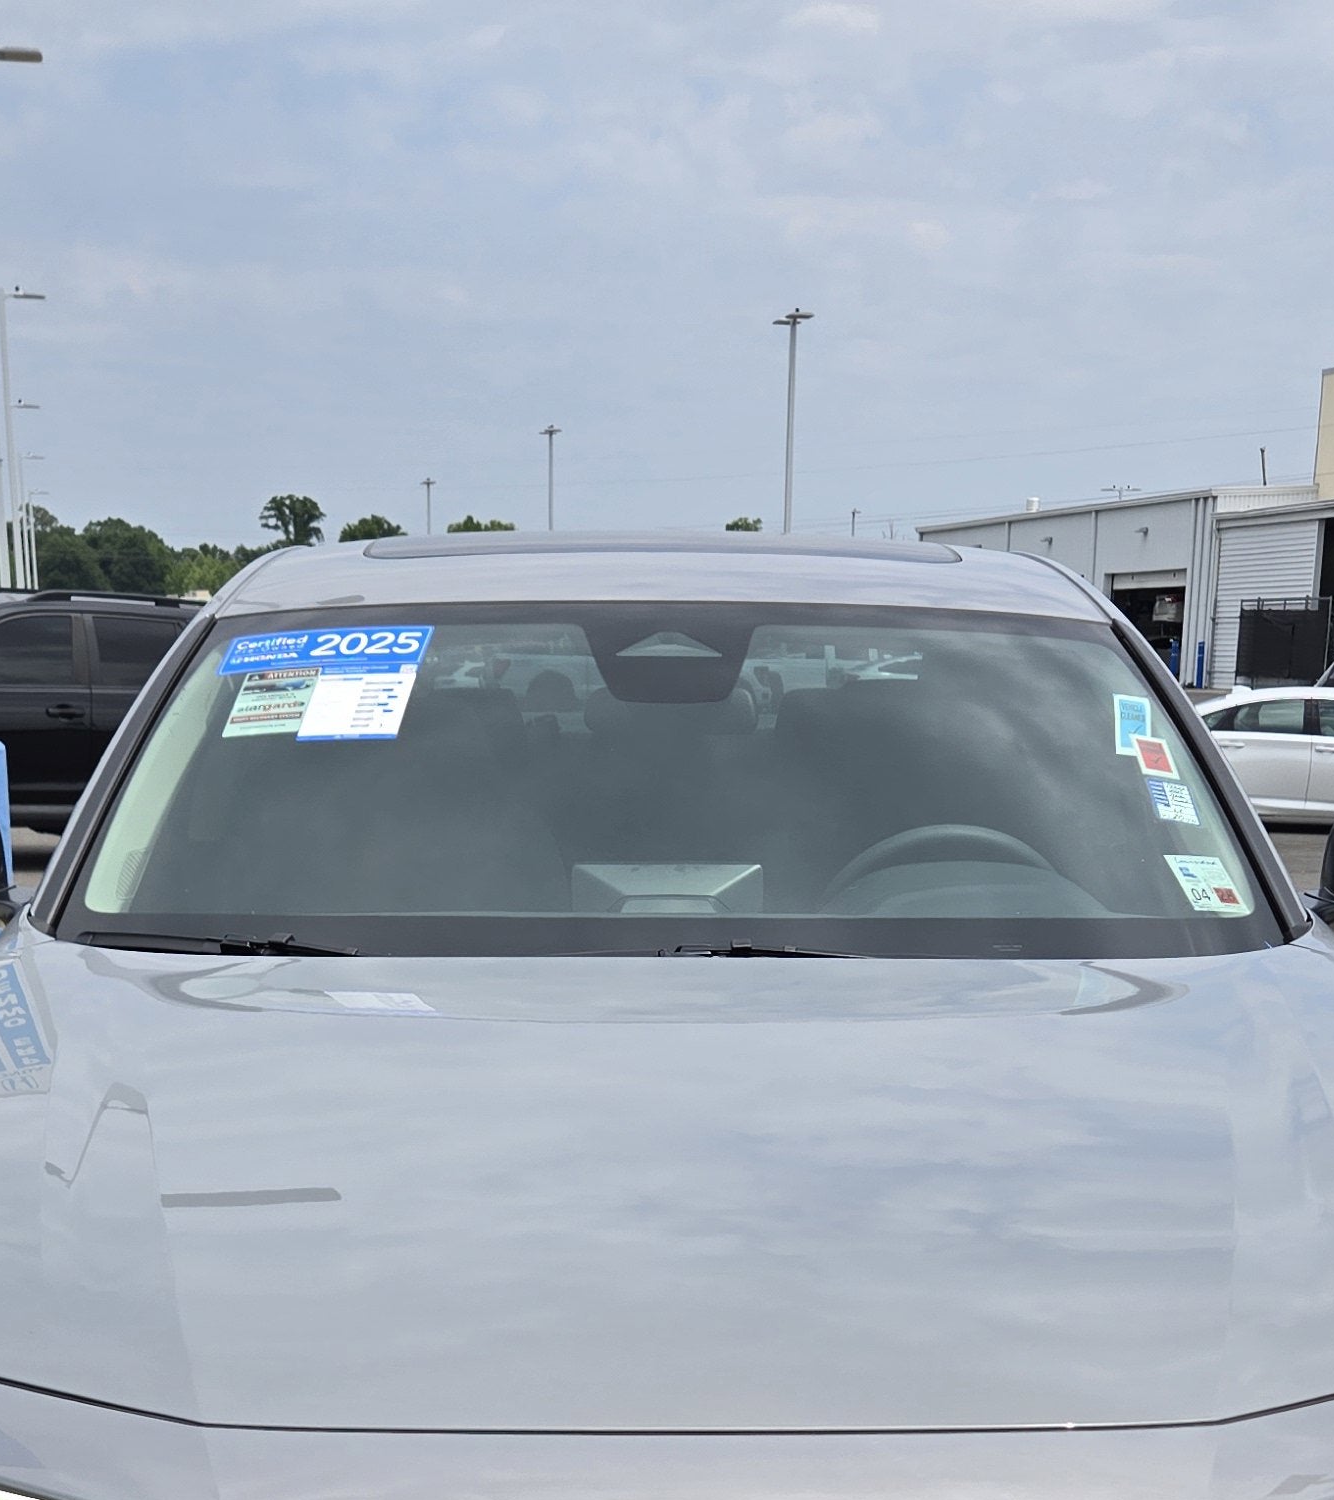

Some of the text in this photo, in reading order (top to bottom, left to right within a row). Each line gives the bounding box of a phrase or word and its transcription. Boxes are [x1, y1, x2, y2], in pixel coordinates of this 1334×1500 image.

[237, 635, 308, 650] Certified
[309, 631, 423, 656] 2025
[1191, 888, 1211, 901] 04
